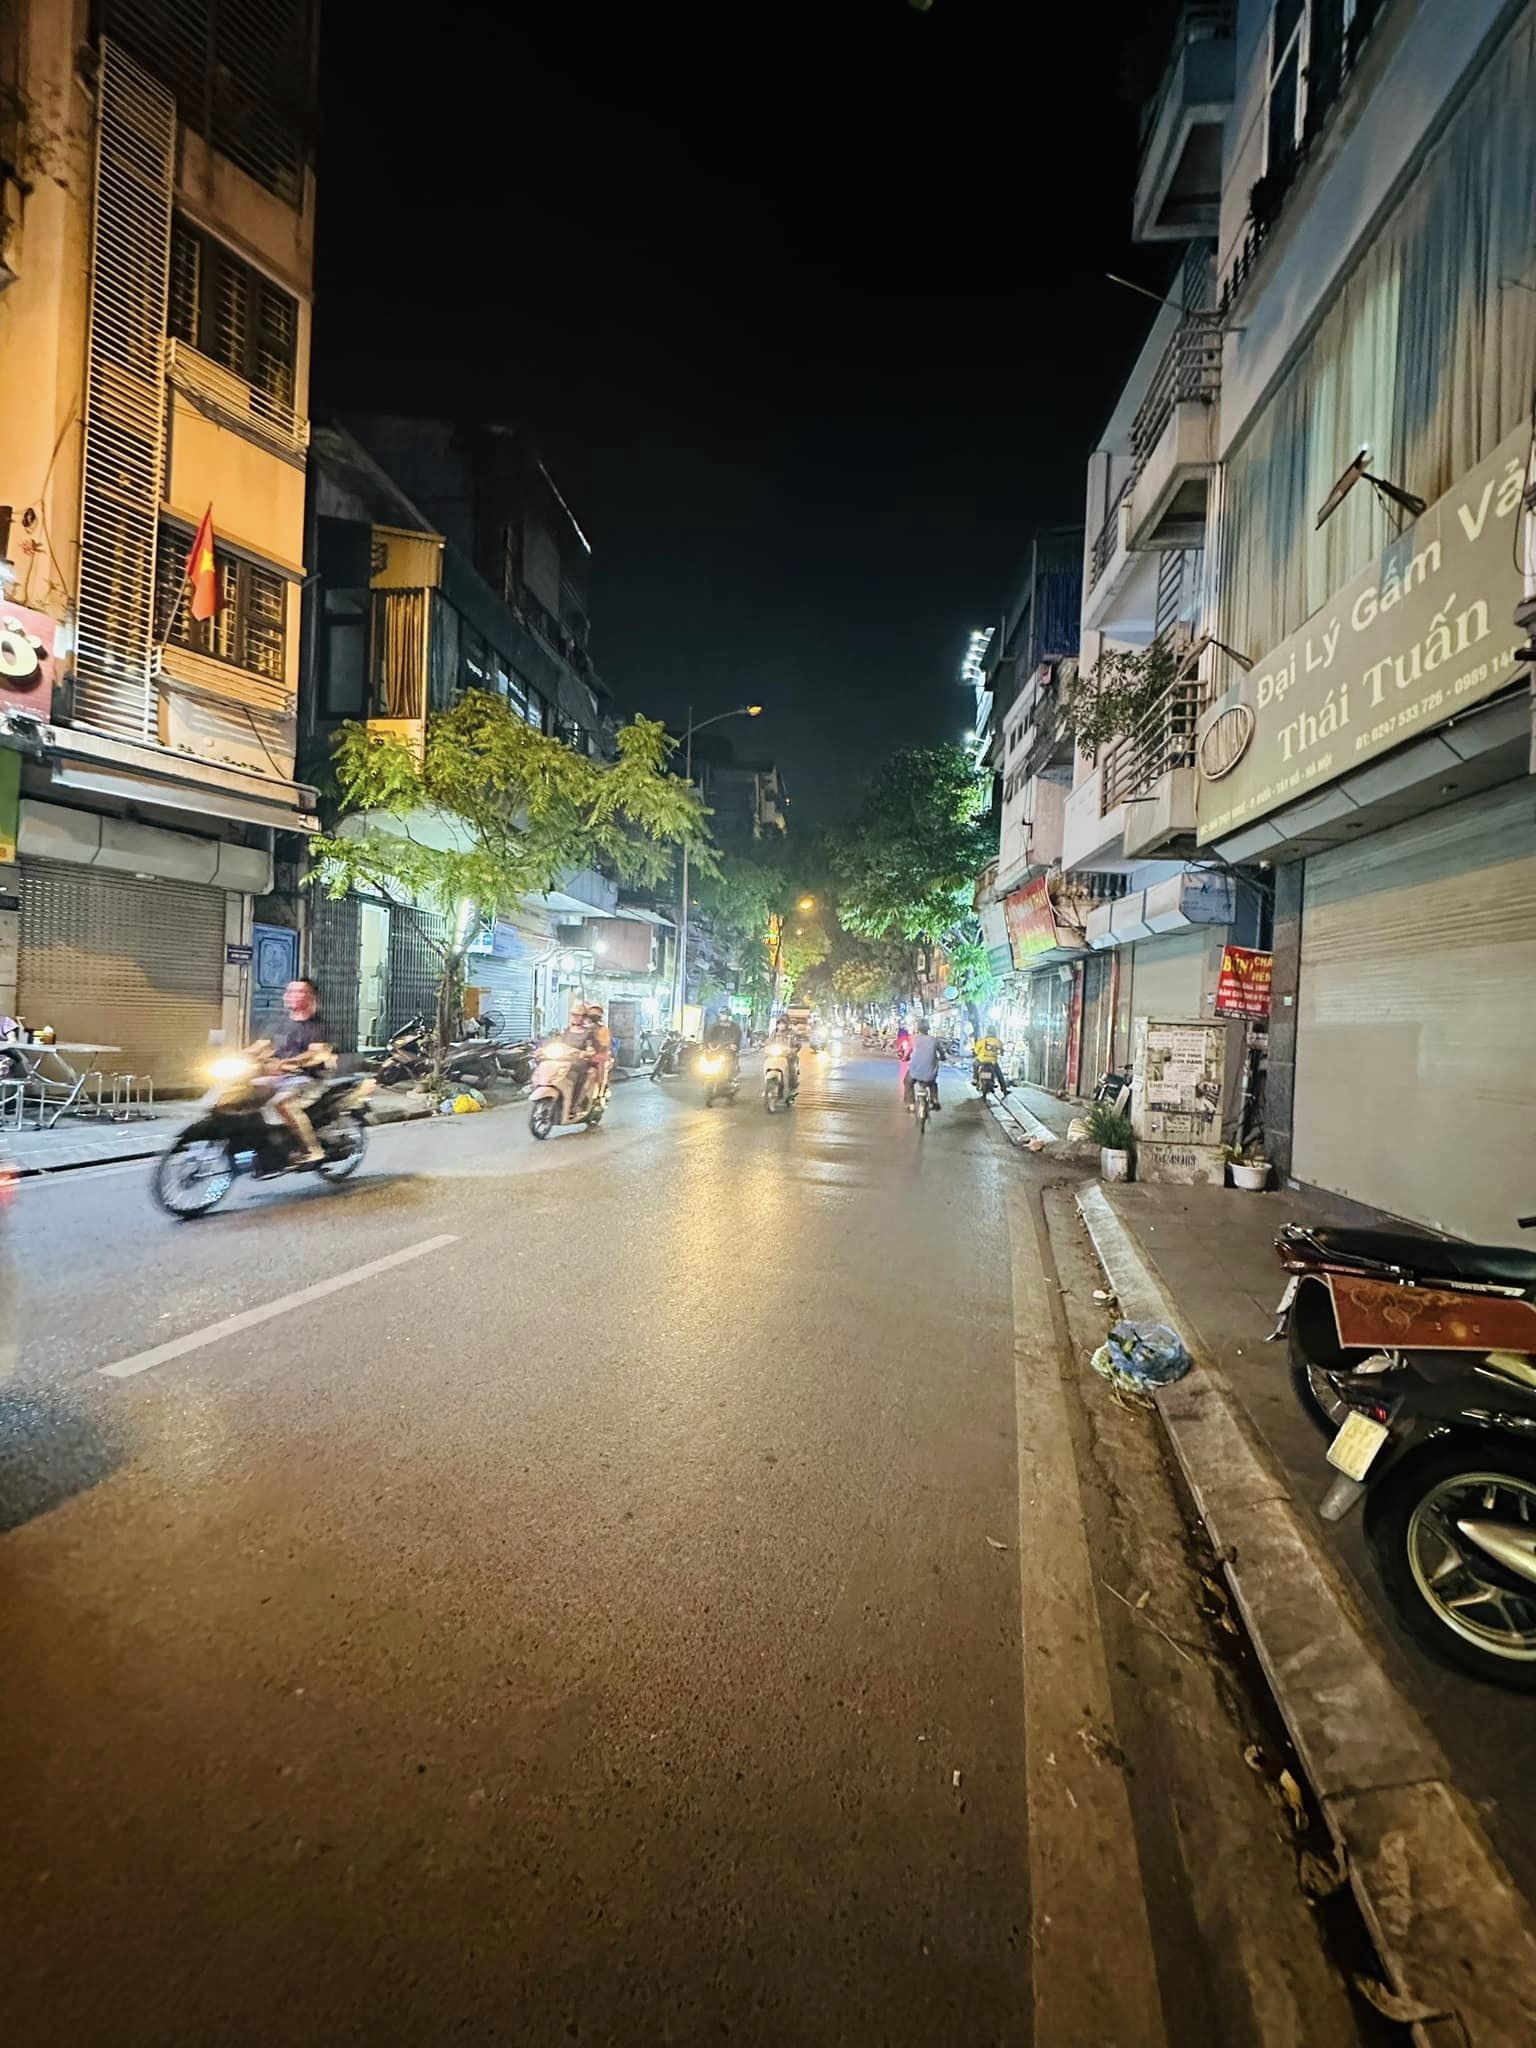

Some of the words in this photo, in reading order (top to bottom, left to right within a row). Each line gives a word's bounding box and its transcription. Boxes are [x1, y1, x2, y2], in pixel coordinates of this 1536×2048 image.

[1257, 652, 1296, 709] Đại
[1305, 615, 1341, 672] Lý
[1352, 540, 1441, 632] Gấm
[1277, 682, 1350, 762] Thái
[1362, 593, 1491, 708] Tuấn
